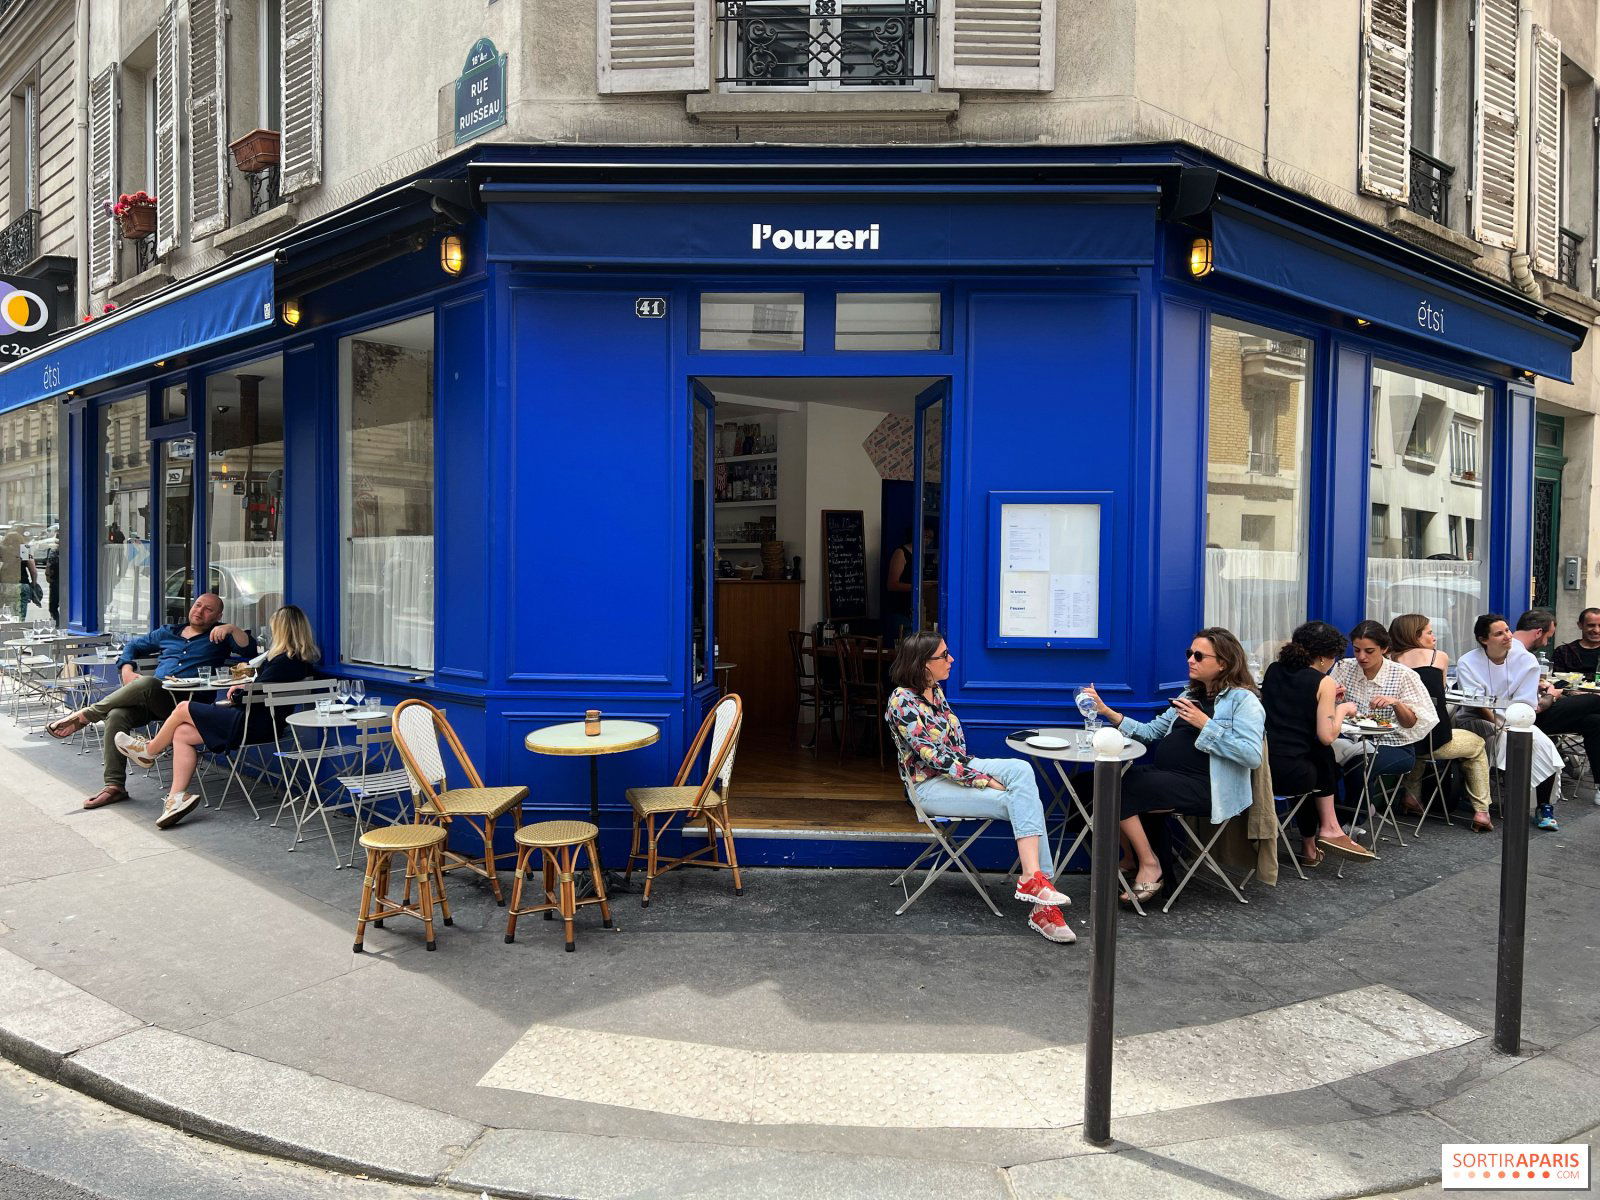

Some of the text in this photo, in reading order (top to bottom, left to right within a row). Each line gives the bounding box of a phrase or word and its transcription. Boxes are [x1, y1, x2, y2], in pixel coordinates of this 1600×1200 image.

[471, 77, 489, 97] RUE
[476, 96, 483, 106] DU
[460, 99, 500, 130] RUISSEAU
[752, 223, 880, 250] l'ouzeri
[640, 300, 660, 315] 41
